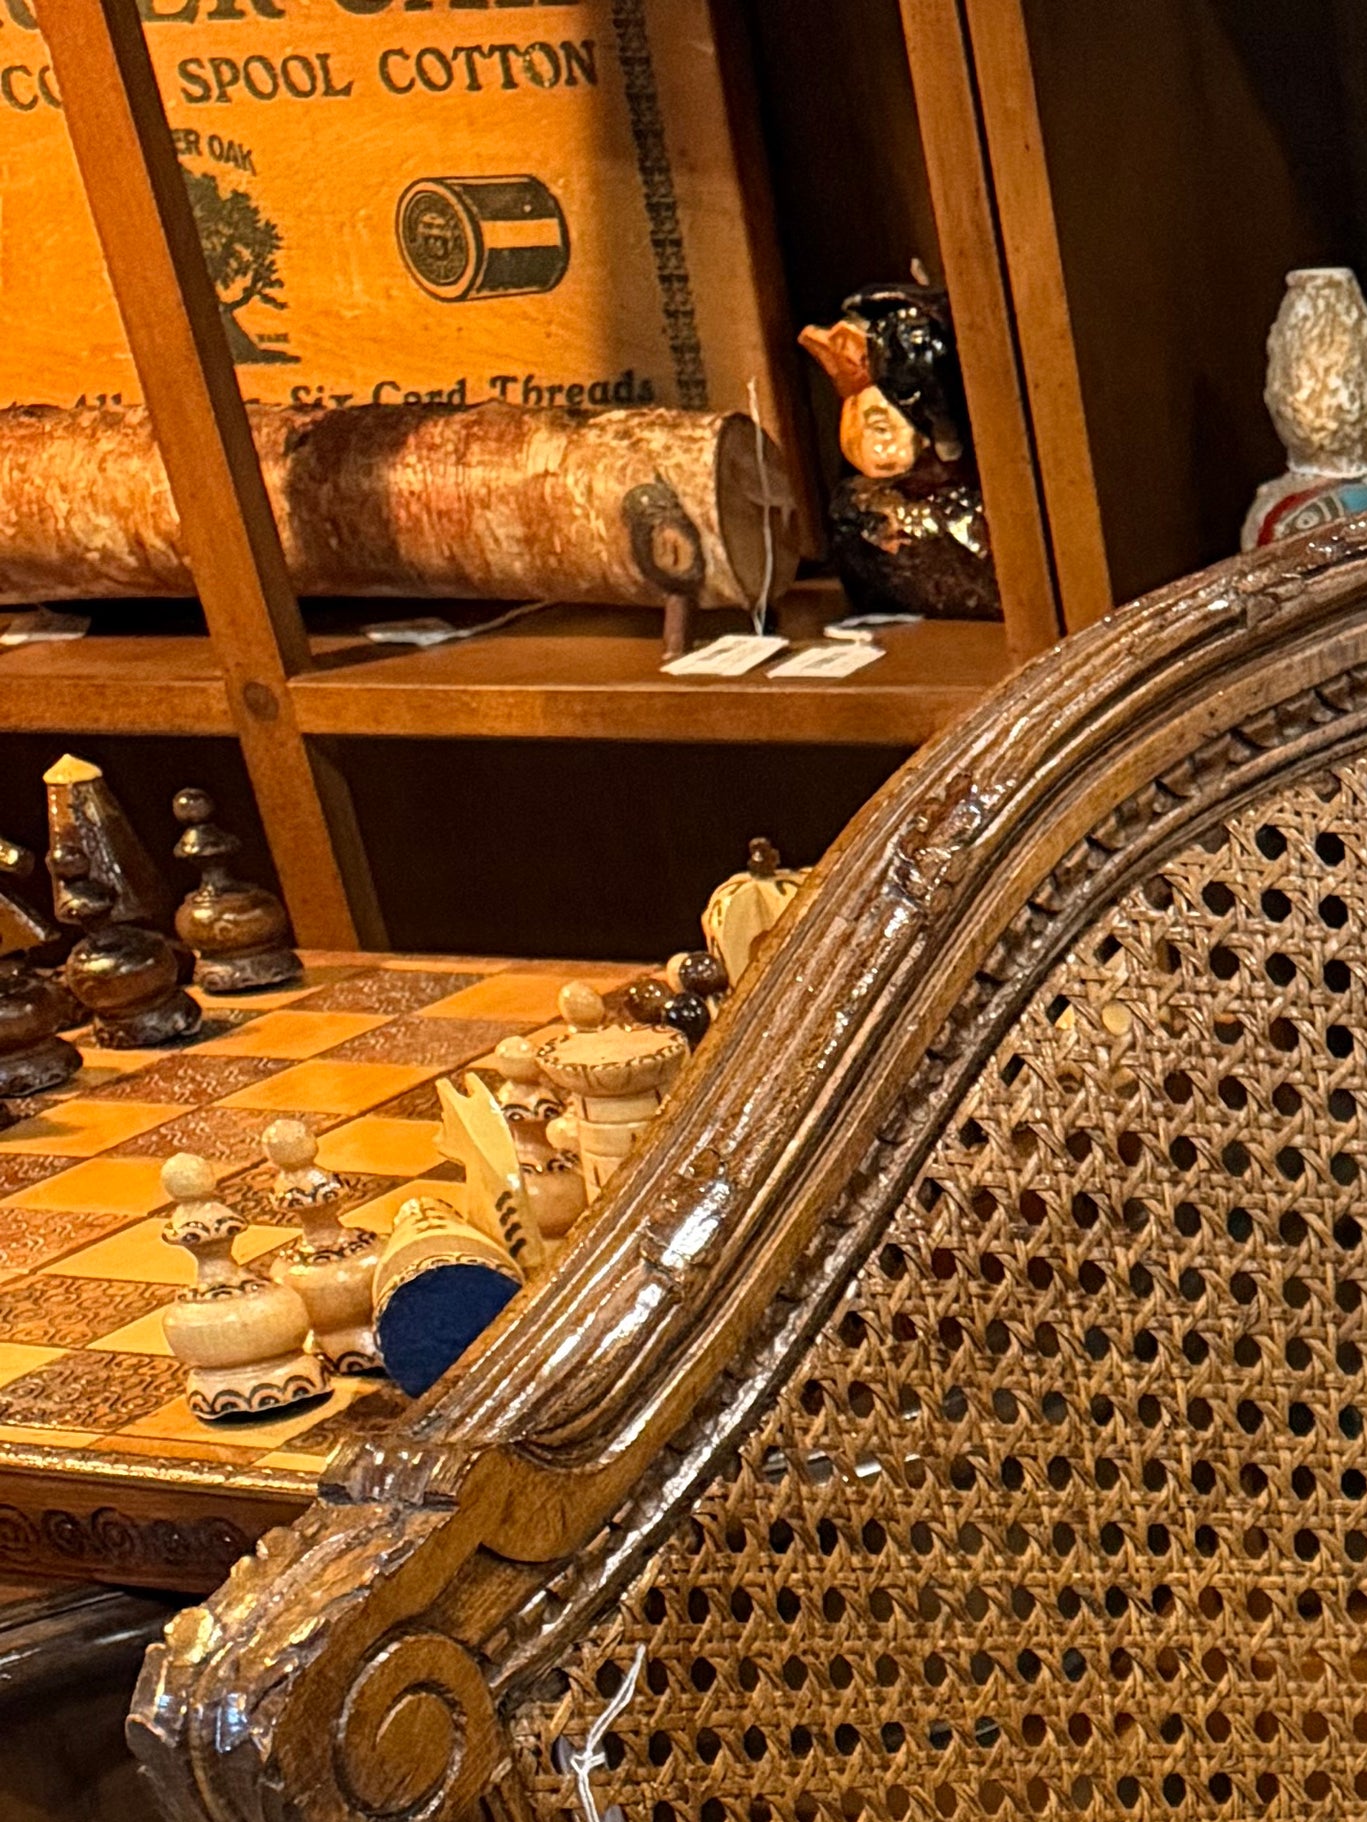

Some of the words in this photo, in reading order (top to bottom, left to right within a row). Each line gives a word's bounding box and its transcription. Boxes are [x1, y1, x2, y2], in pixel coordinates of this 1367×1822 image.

[178, 52, 354, 104] SPOOL
[378, 39, 599, 95] COTTON
[208, 134, 257, 177] OAK
[489, 369, 655, 407] Threads
